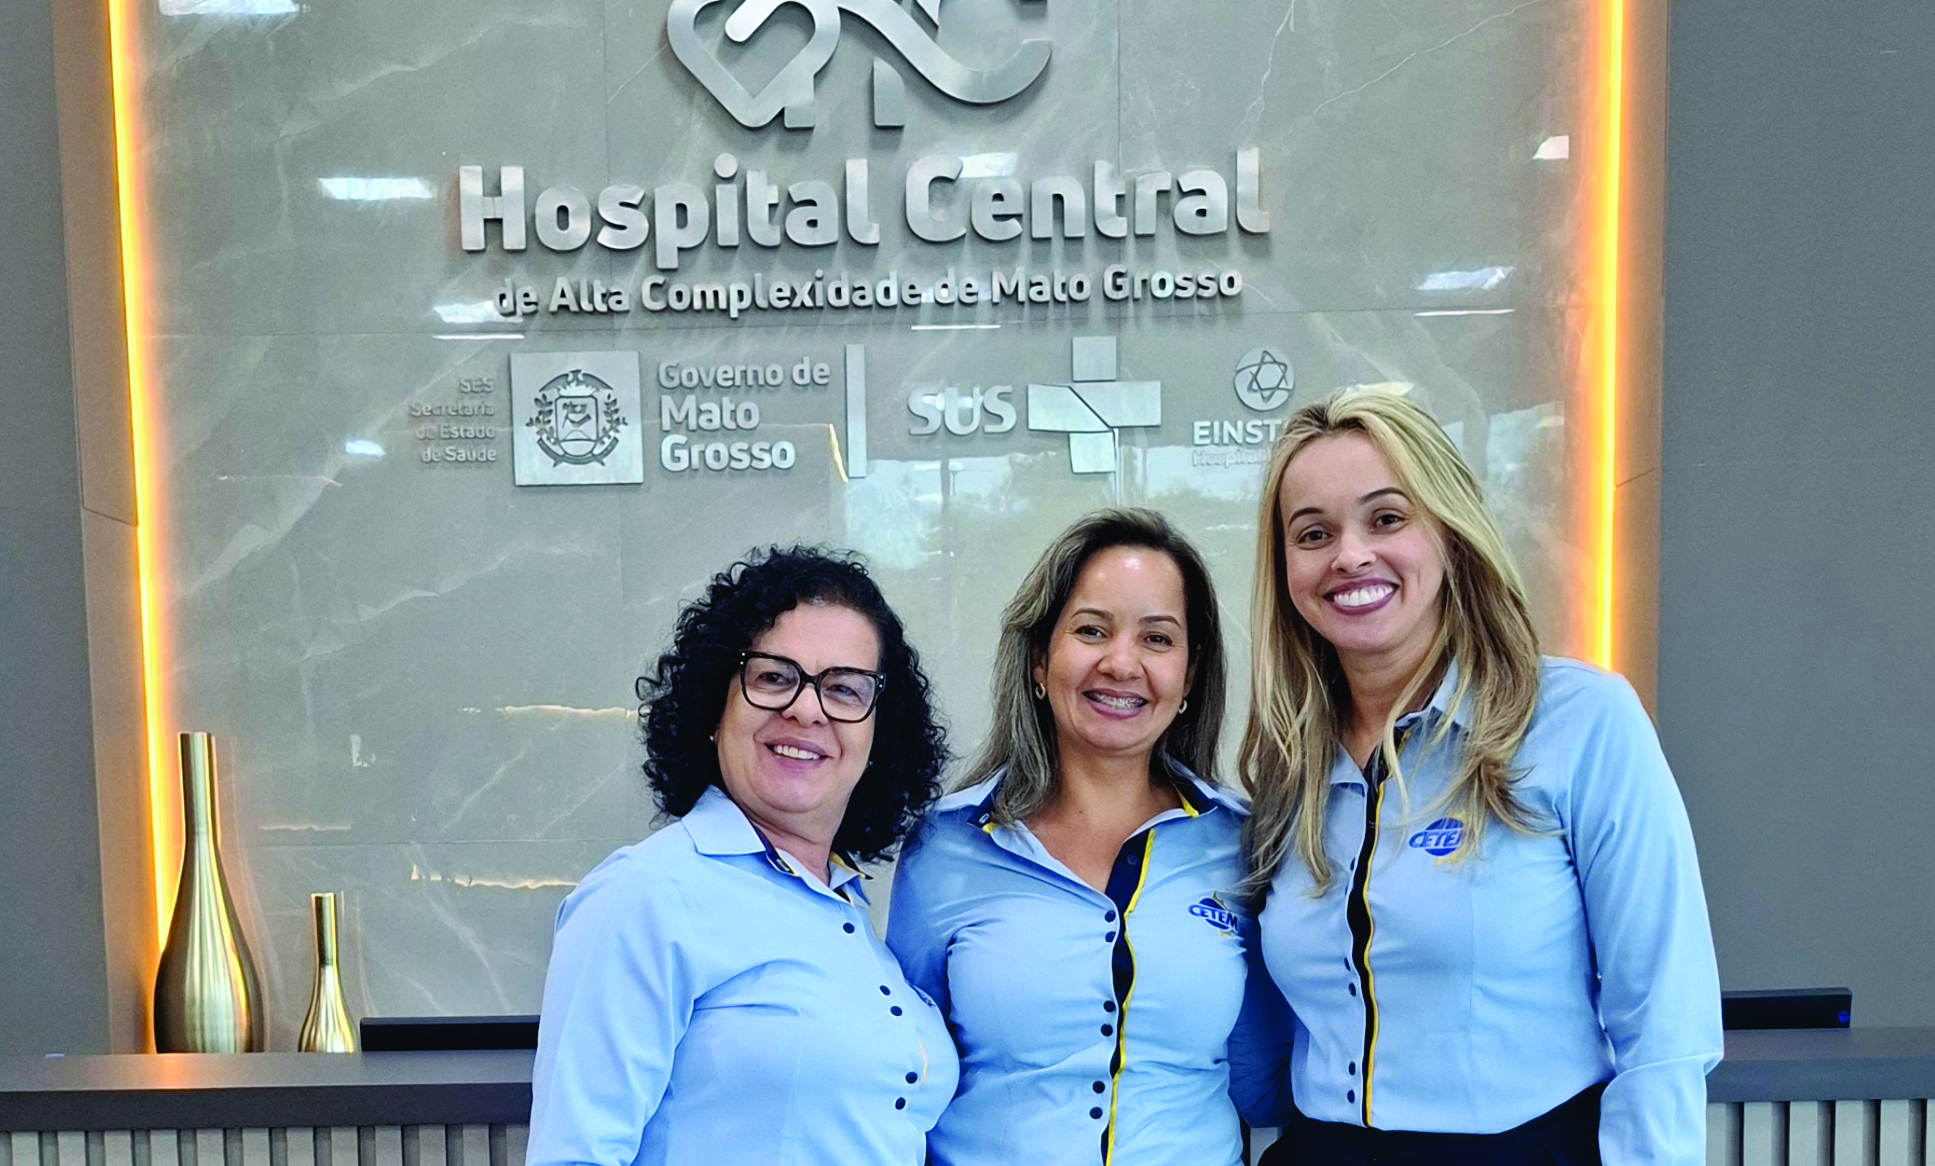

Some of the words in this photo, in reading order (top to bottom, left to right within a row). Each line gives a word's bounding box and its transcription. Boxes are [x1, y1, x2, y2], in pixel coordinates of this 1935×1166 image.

[459, 153, 879, 269] Hospital
[906, 147, 1269, 242] Central
[495, 278, 538, 316] de
[549, 277, 630, 312] Alta
[641, 269, 922, 319] Complexidade
[934, 268, 978, 305] de
[991, 267, 1091, 304] Mato
[1103, 264, 1242, 300] Grosso
[460, 377, 494, 393] SES
[659, 360, 784, 388] Governo
[792, 356, 830, 386] de
[409, 401, 495, 417] Secretaria
[661, 394, 760, 431] Mato
[908, 385, 1016, 436] SUS
[415, 424, 437, 440] de
[441, 423, 496, 440] Estado
[1193, 419, 1283, 445] EINST
[421, 446, 441, 462] de
[661, 434, 795, 471] Grosso
[1188, 903, 1238, 931] CETEM
